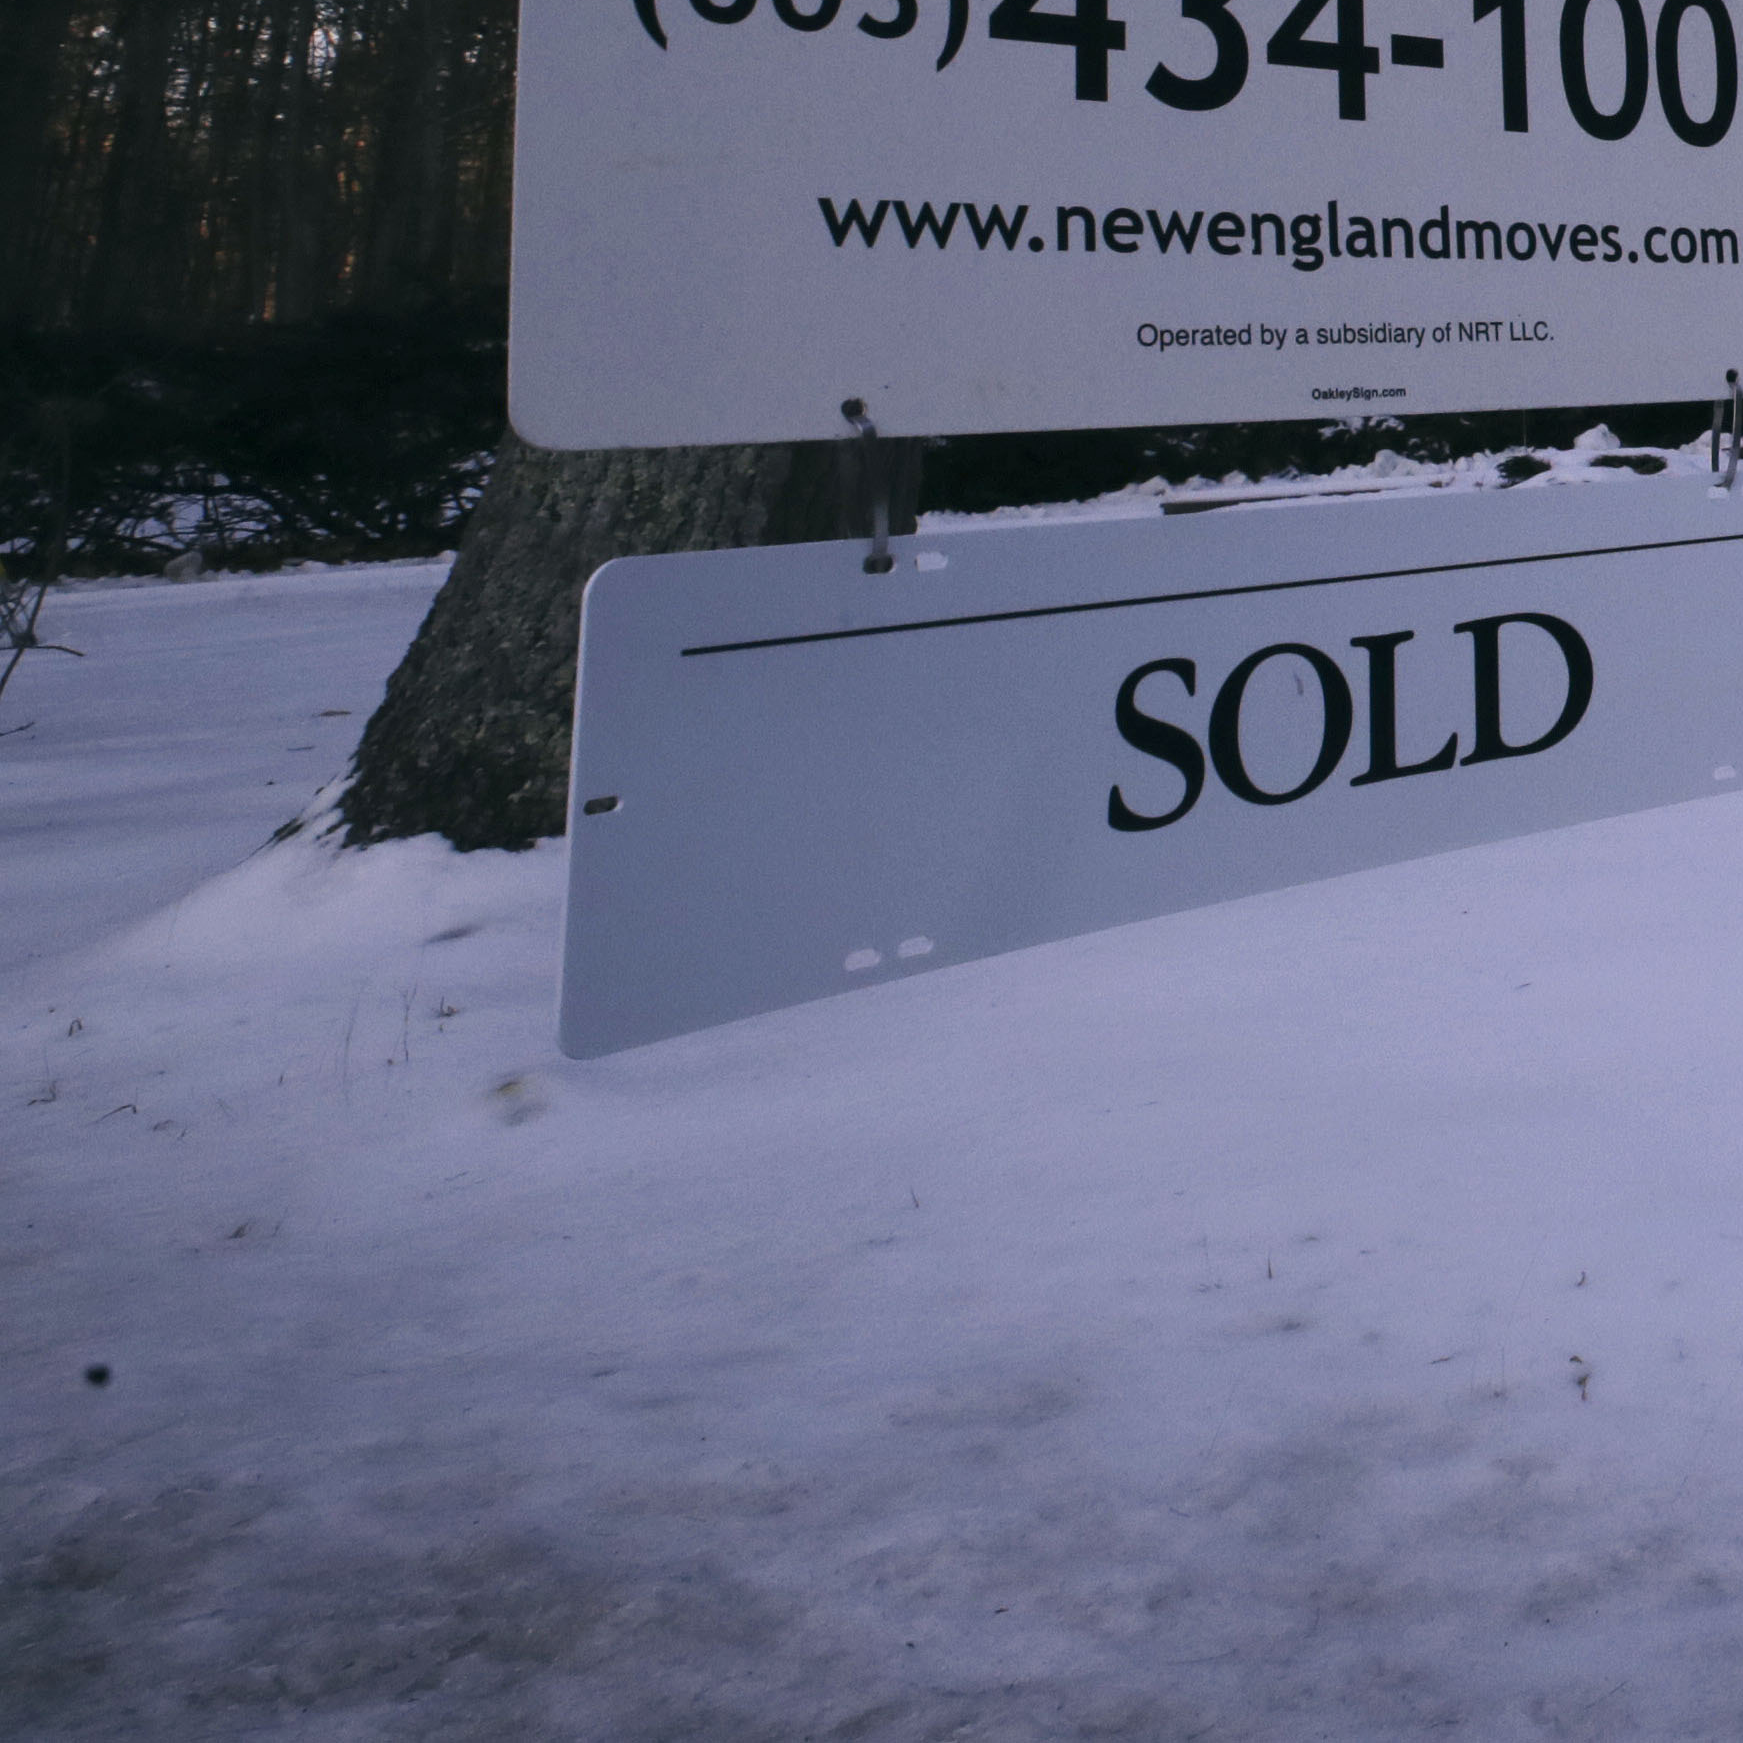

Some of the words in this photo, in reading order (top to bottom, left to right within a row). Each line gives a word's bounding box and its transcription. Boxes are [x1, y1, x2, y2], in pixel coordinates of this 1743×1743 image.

[817, 197, 1740, 272] www.newenglandmoves.com
[1136, 323, 1252, 353] Operated
[1260, 323, 1288, 351] by
[1295, 327, 1310, 346] a
[1316, 322, 1426, 349] subsidiary
[1431, 321, 1452, 344] of
[1458, 321, 1504, 343] NRT
[1509, 320, 1555, 342] LLC.
[1107, 612, 1594, 833] SOLD
